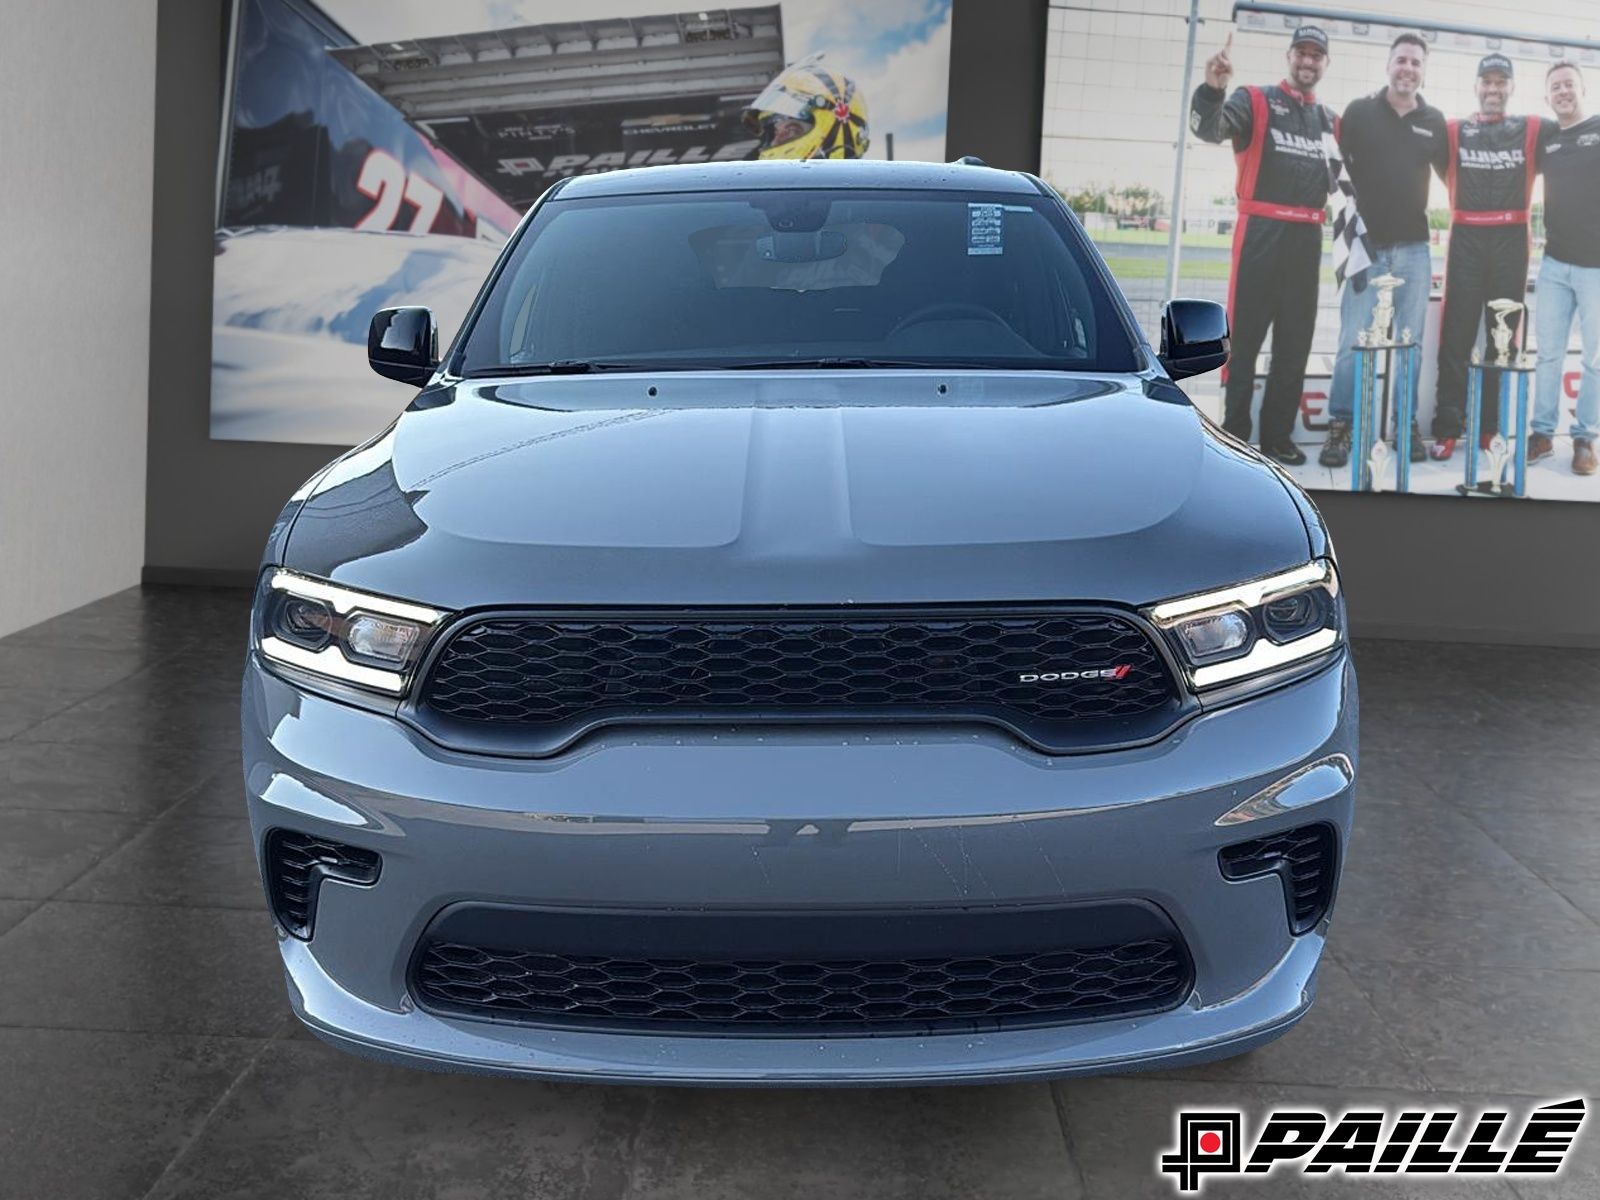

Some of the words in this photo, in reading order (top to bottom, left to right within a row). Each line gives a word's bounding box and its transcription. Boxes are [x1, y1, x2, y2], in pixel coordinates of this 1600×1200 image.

[622, 123, 718, 135] CHEVROLET
[355, 148, 444, 234] 27
[1020, 669, 1117, 682] DODGE
